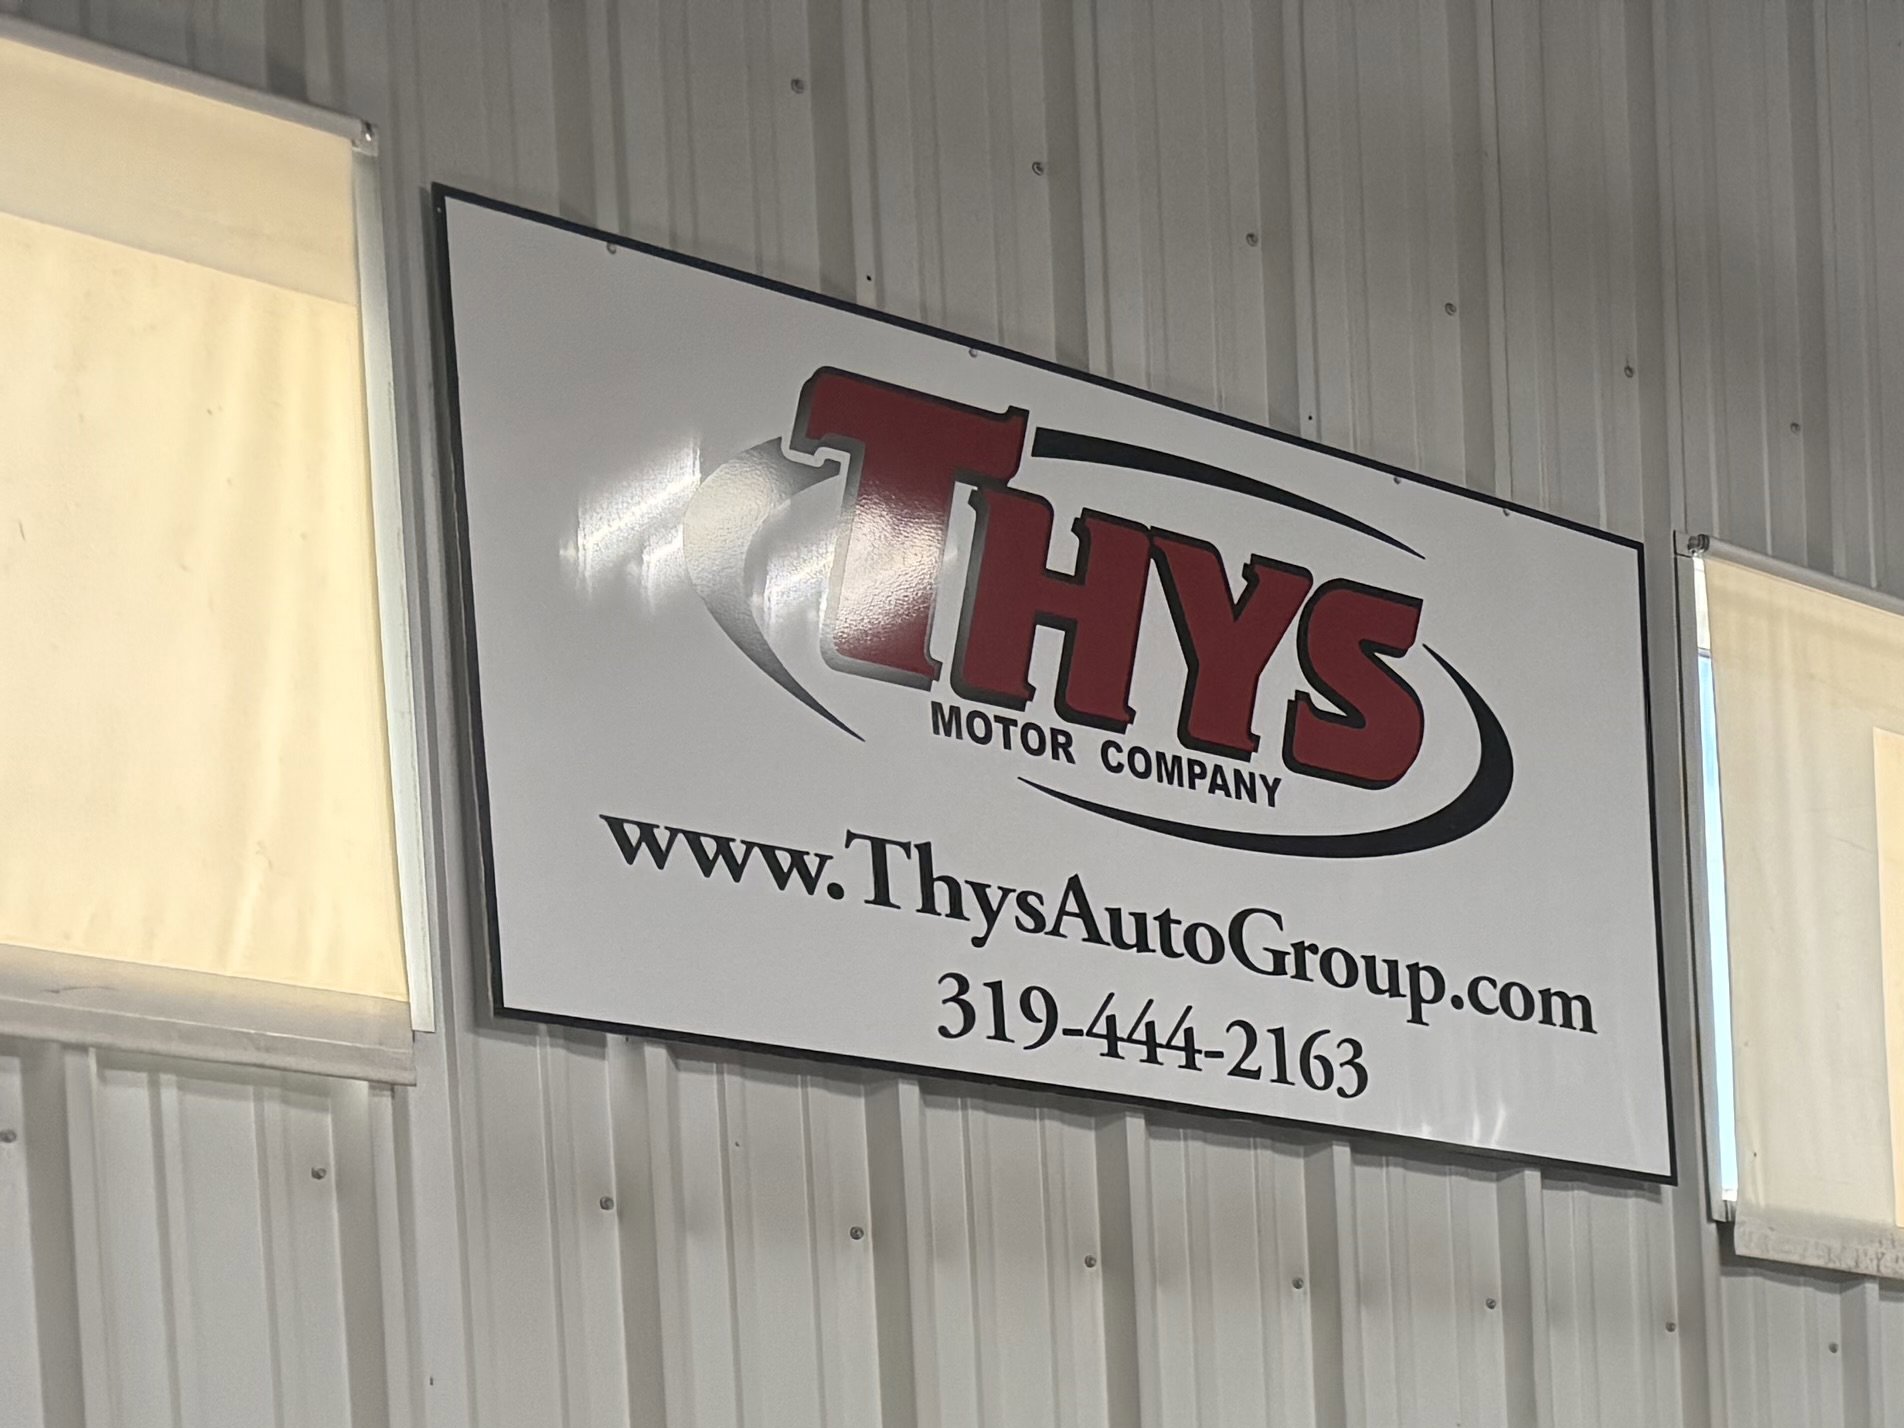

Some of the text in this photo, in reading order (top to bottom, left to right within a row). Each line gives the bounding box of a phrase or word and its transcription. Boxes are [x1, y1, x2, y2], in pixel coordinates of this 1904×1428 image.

[929, 699, 1283, 809] MOTOR COMPANY
[598, 813, 1600, 1036] www.ThysAutoGroup.com
[935, 971, 1372, 1100] 319-444-2163
